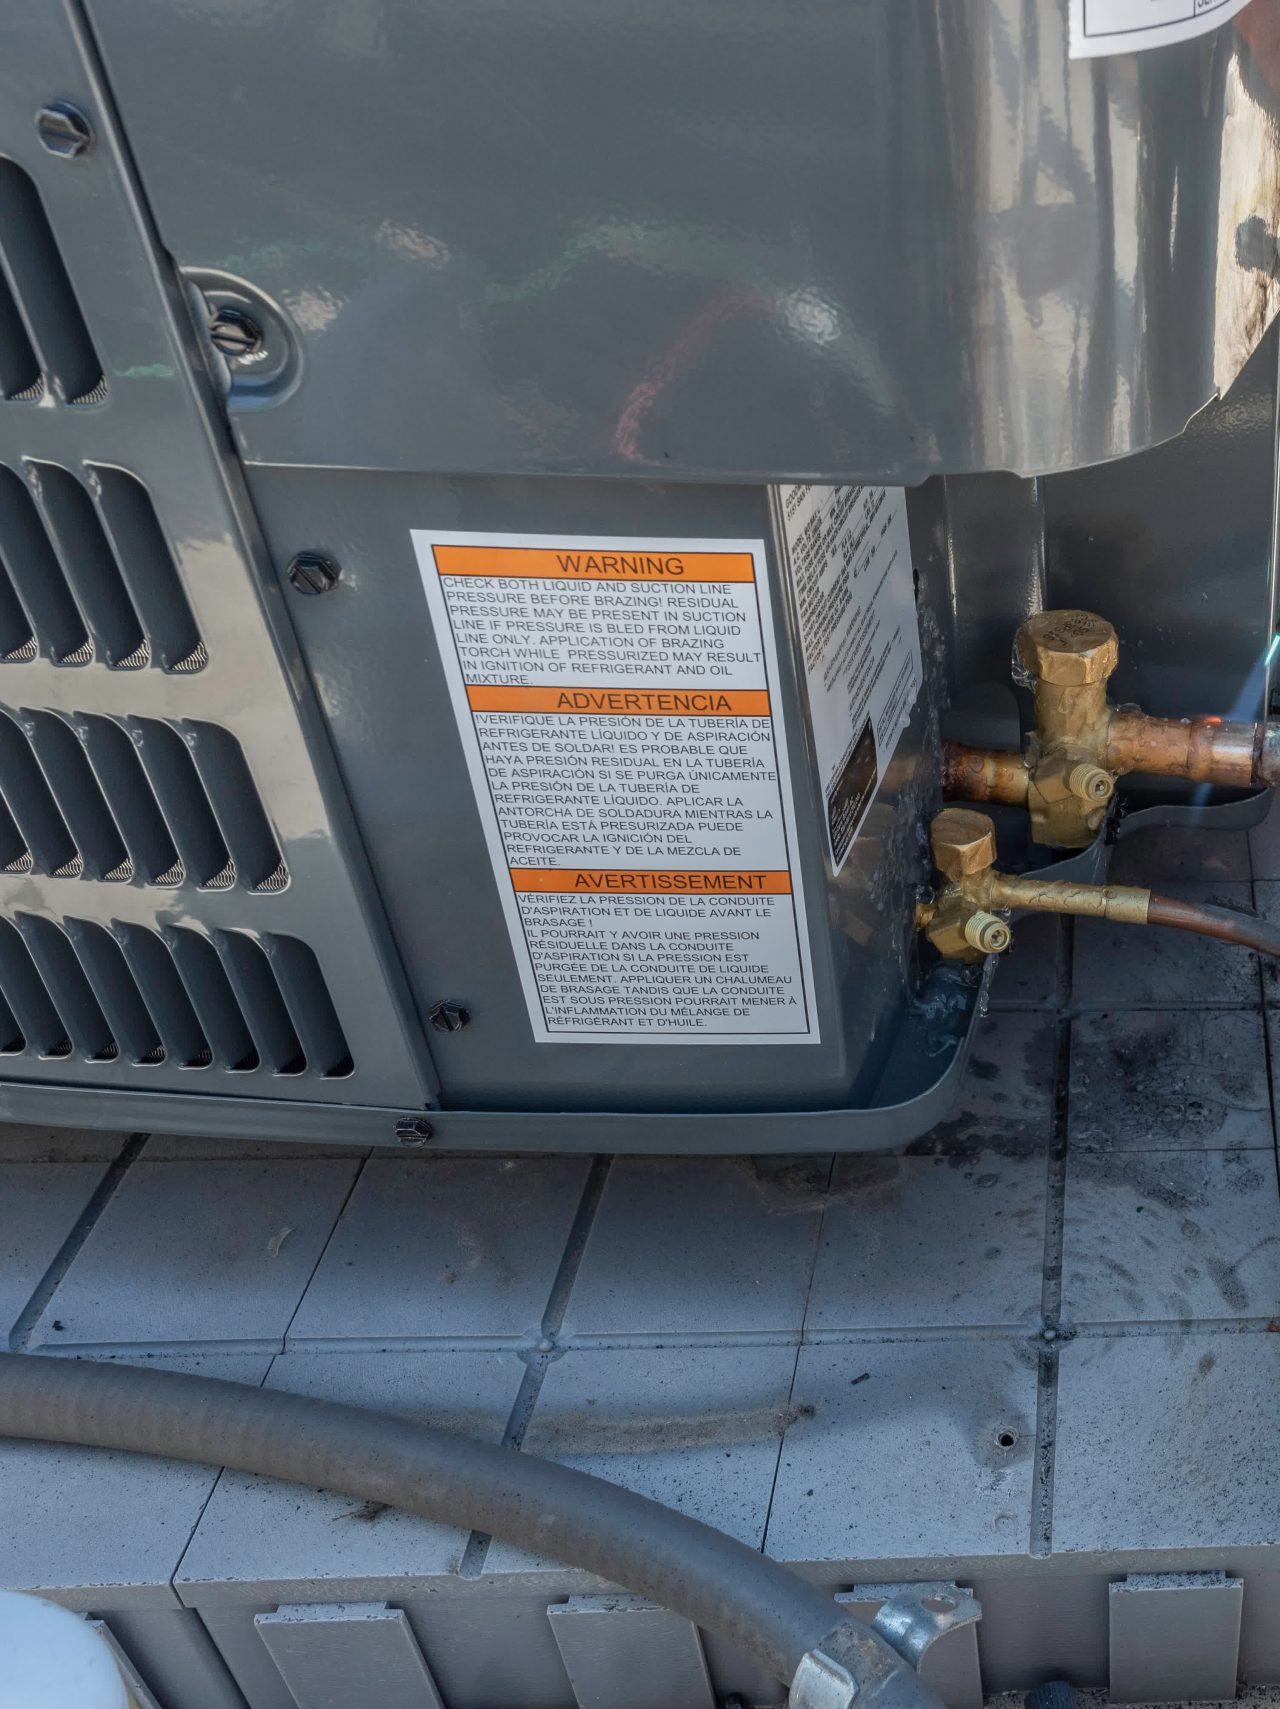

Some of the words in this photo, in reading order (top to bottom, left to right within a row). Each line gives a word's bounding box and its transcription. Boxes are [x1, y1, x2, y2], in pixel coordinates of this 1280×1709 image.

[557, 554, 685, 575] WARNING
[441, 577, 496, 590] CHECK
[496, 578, 540, 591] BOTH
[541, 579, 593, 592] LIQUID
[594, 581, 627, 593] AND
[629, 582, 696, 594] SUCTION
[699, 583, 732, 595] LINE
[445, 591, 527, 603] PRESSURE
[529, 593, 591, 605] BEFORE
[593, 595, 663, 607] BRAZING!
[666, 596, 739, 609] RESIDUAL
[448, 605, 530, 617] PRESSURE
[532, 608, 565, 618] MAY
[567, 608, 588, 619] BE
[591, 609, 660, 620] PRESENT
[663, 611, 679, 621] IN
[681, 611, 746, 622] SUCTION
[452, 619, 486, 630] LINE
[488, 620, 503, 629] IF
[504, 620, 585, 632] PRESSURE
[587, 623, 604, 633] IS
[605, 623, 645, 634] BLED
[647, 624, 690, 634] FROM
[693, 624, 741, 635] LIQUID
[455, 633, 489, 643] LINE
[490, 633, 535, 645] ONLY.
[537, 635, 634, 647] APPLICATION
[636, 637, 658, 647] OF
[660, 637, 727, 649] BRAZING
[457, 646, 511, 657] TORCH
[513, 648, 561, 659] WHILE
[567, 649, 669, 661] PRESSURIZED
[671, 651, 704, 661] MAY
[706, 651, 763, 662] RESULT
[462, 660, 478, 669] IN
[479, 660, 544, 671] IGNITION
[546, 662, 568, 672] OF
[570, 662, 673, 674] REFRIGERANT
[674, 664, 708, 675] AND
[708, 665, 733, 675] OIL
[465, 673, 533, 684] MIXTURE.
[556, 692, 732, 711] ADVERTENCIA
[475, 714, 555, 725] !VERIFIQUE
[558, 716, 575, 726] LA
[578, 714, 642, 727] PRESIÓN
[644, 717, 664, 727] DE
[667, 718, 685, 727] LA
[688, 715, 748, 728] TUBERÍA
[751, 718, 770, 728] DE
[478, 728, 587, 739] REFRIGERANTE
[590, 727, 648, 740] LÍQUIDO
[650, 731, 660, 740] Y
[663, 731, 682, 741] DE
[685, 729, 770, 742] ASPIRACIÓN
[481, 741, 528, 751] ANTES
[531, 742, 551, 752] DE
[553, 742, 615, 753] SOLDAR!
[618, 744, 638, 754] ES
[641, 744, 715, 755] PROBABLE
[718, 745, 748, 755] QUE
[484, 755, 523, 764] HAYA
[525, 753, 587, 765] PRESIÓN
[590, 756, 659, 767] RESIDUAL
[663, 758, 682, 767] EN
[685, 758, 703, 767] LA
[705, 756, 764, 768] TUBERÍA
[487, 767, 508, 777] DE
[510, 766, 595, 778] ASPIRACIÓN
[598, 769, 611, 779] SI
[614, 770, 633, 779] SE
[636, 770, 685, 780] PURGA
[688, 768, 776, 781] ÚNICAMENTE
[491, 781, 508, 790] LA
[510, 779, 573, 791] PRESIÓN
[575, 782, 595, 792] DE
[598, 783, 616, 792] LA
[618, 780, 678, 793] TUBERÍA
[681, 784, 700, 793] DE
[494, 793, 600, 804] REFRIGERANTE
[602, 793, 662, 805] LÍQUIDO.
[665, 796, 723, 806] APLICAR
[726, 797, 743, 806] LA
[497, 806, 573, 817] ANTORCHA
[575, 808, 594, 817] DE
[597, 808, 681, 818] SOLDADURA
[684, 809, 753, 819] MIENTRAS
[756, 810, 773, 819] LA
[502, 832, 580, 842] PROVOCAR
[582, 834, 600, 842] LA
[601, 831, 663, 843] IGNICIÓN
[665, 834, 693, 843] DEL
[506, 844, 610, 854] REFRIGERANTE
[612, 846, 622, 854] Y
[625, 846, 644, 854] DE
[646, 846, 663, 855] LA
[666, 846, 720, 855] MEZCLA
[722, 847, 741, 855] DE
[508, 856, 560, 865] ACEITE.
[574, 873, 768, 889] AVERTISSEMENT
[517, 892, 577, 903] VÉRIFIEZ
[579, 896, 596, 904] LA
[598, 895, 665, 905] PRESSION
[668, 896, 686, 905] DE
[689, 897, 705, 905] LA
[708, 896, 775, 905] CONDUITE
[520, 906, 611, 915] D'ASPIRATION
[613, 907, 630, 916] ET
[633, 908, 652, 916] DE
[654, 908, 706, 917] LIQUIDE
[707, 908, 751, 917] AVANT
[755, 908, 771, 917] LE
[523, 918, 586, 926] BRASAGE
[526, 929, 538, 937] IL
[540, 929, 607, 938] POURRAIT
[609, 930, 618, 938] Y
[620, 930, 661, 939] AVOIR
[664, 931, 691, 940] UNE
[693, 931, 760, 940] PRESSION
[528, 938, 608, 949] RÉSIDUELLE
[610, 942, 646, 950] DANS
[649, 942, 665, 950] LA
[668, 942, 734, 951] CONDUITE
[531, 952, 619, 960] D'ASPIRATION
[622, 953, 635, 961] SI
[656, 953, 721, 962] PRESSION
[724, 953, 749, 962] EST
[537, 974, 616, 982] SEULEMENT.
[619, 975, 692, 983] APPLIQUER
[715, 976, 792, 984] CHALUMEAU
[539, 984, 557, 992] DE
[560, 985, 620, 993] BRASAGE
[623, 986, 669, 994] TANDIS
[672, 986, 699, 994] QUE
[720, 986, 784, 994] CONDUITE
[545, 1006, 646, 1015] L'INFLAMMATION
[669, 1006, 730, 1016] MÉLANGE
[546, 1015, 635, 1025] RÉFRIGÉRANT
[656, 1018, 707, 1026] D'HUILE.
